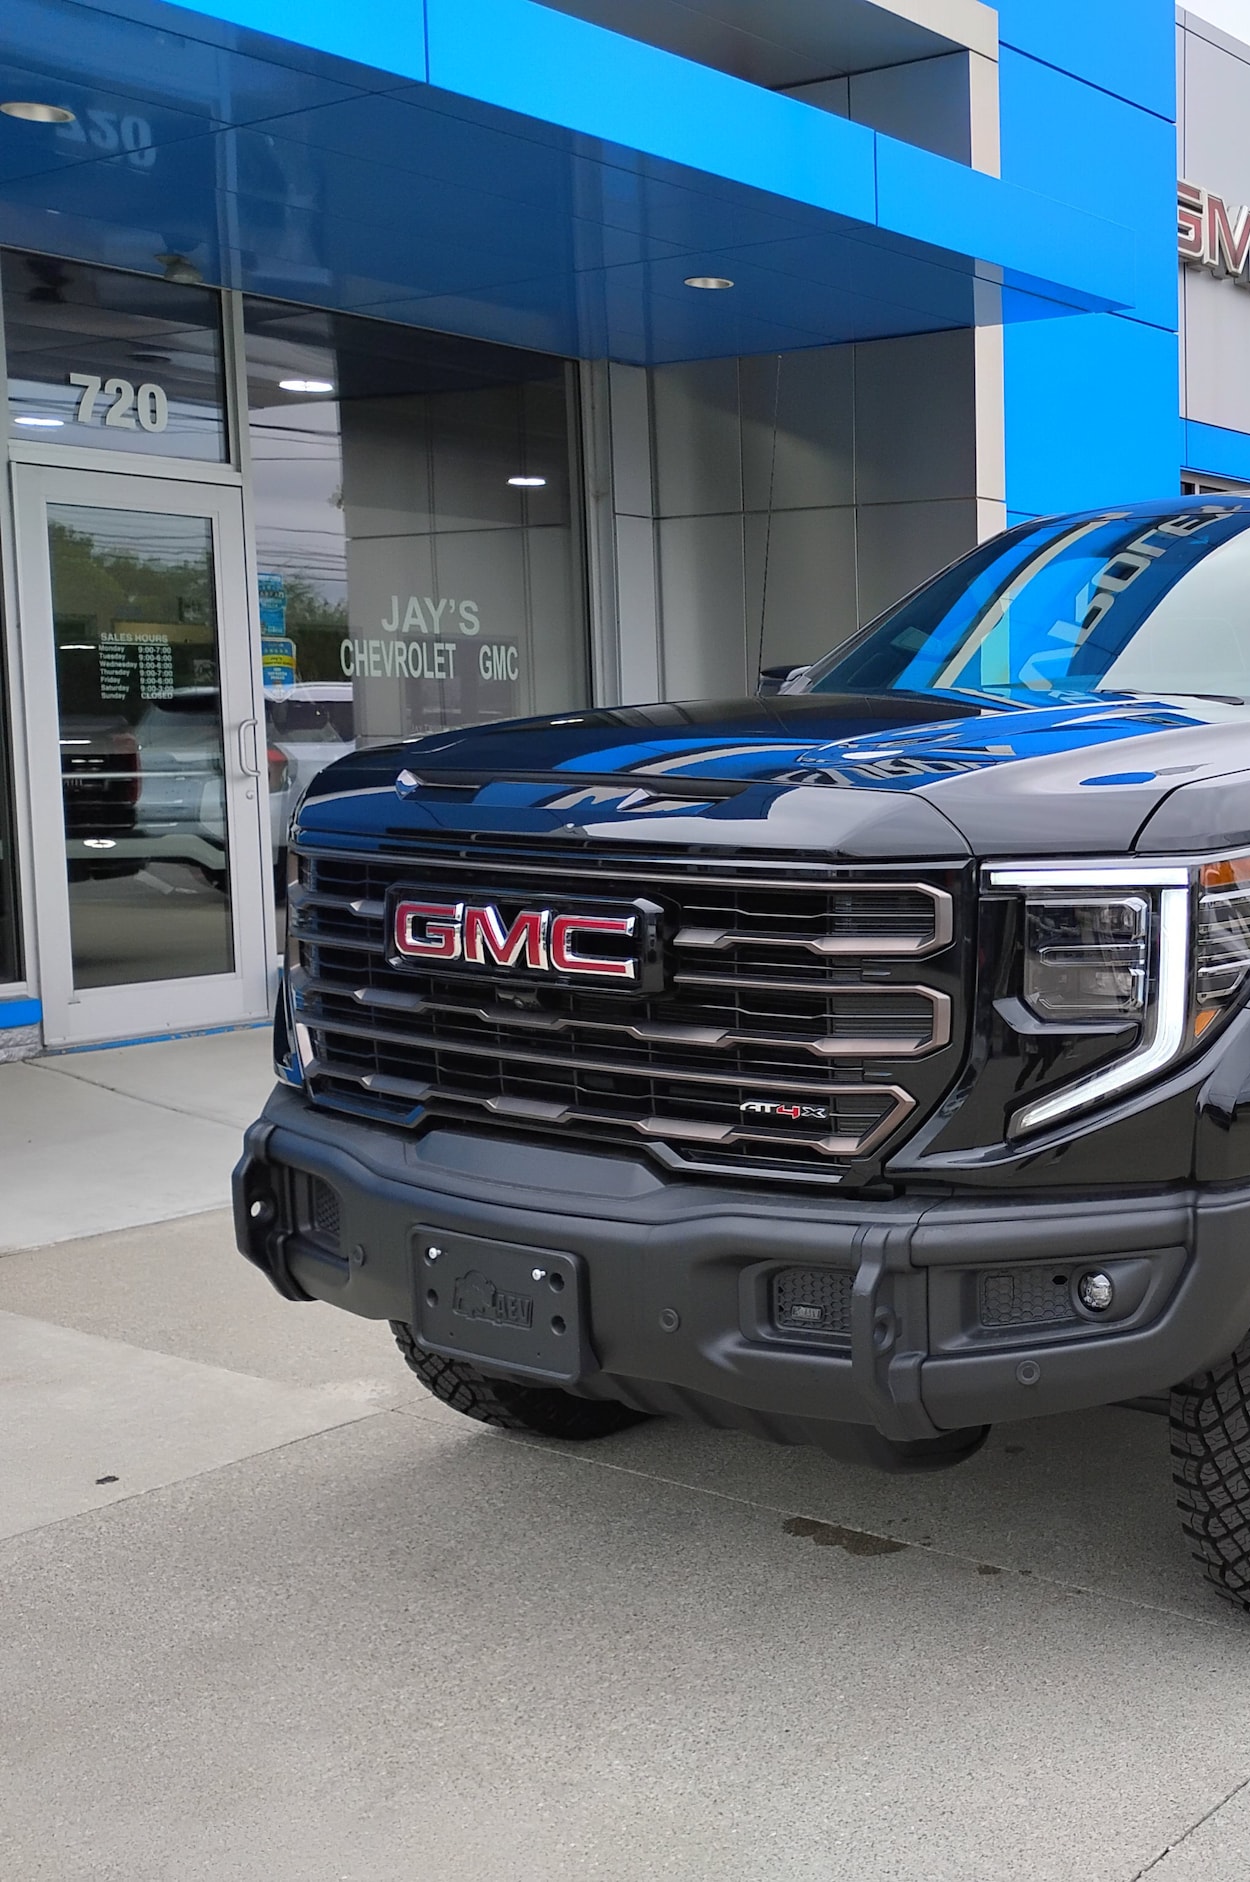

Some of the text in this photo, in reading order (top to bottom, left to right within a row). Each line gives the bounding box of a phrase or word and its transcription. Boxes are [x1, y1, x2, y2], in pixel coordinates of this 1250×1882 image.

[69, 372, 169, 433] 720
[381, 595, 481, 636] JAY'S
[101, 633, 168, 642] SALES HOURS
[99, 645, 125, 653] Monday
[99, 653, 126, 661] Tuesday
[340, 638, 519, 681] CHEVROLET GMC
[99, 661, 137, 669] Wednesday
[100, 669, 173, 678] Thursday 9:00-7:00
[101, 677, 121, 685] Friday
[101, 685, 129, 693] Saturday
[394, 900, 637, 979] GMC
[739, 1100, 828, 1119] AT4X
